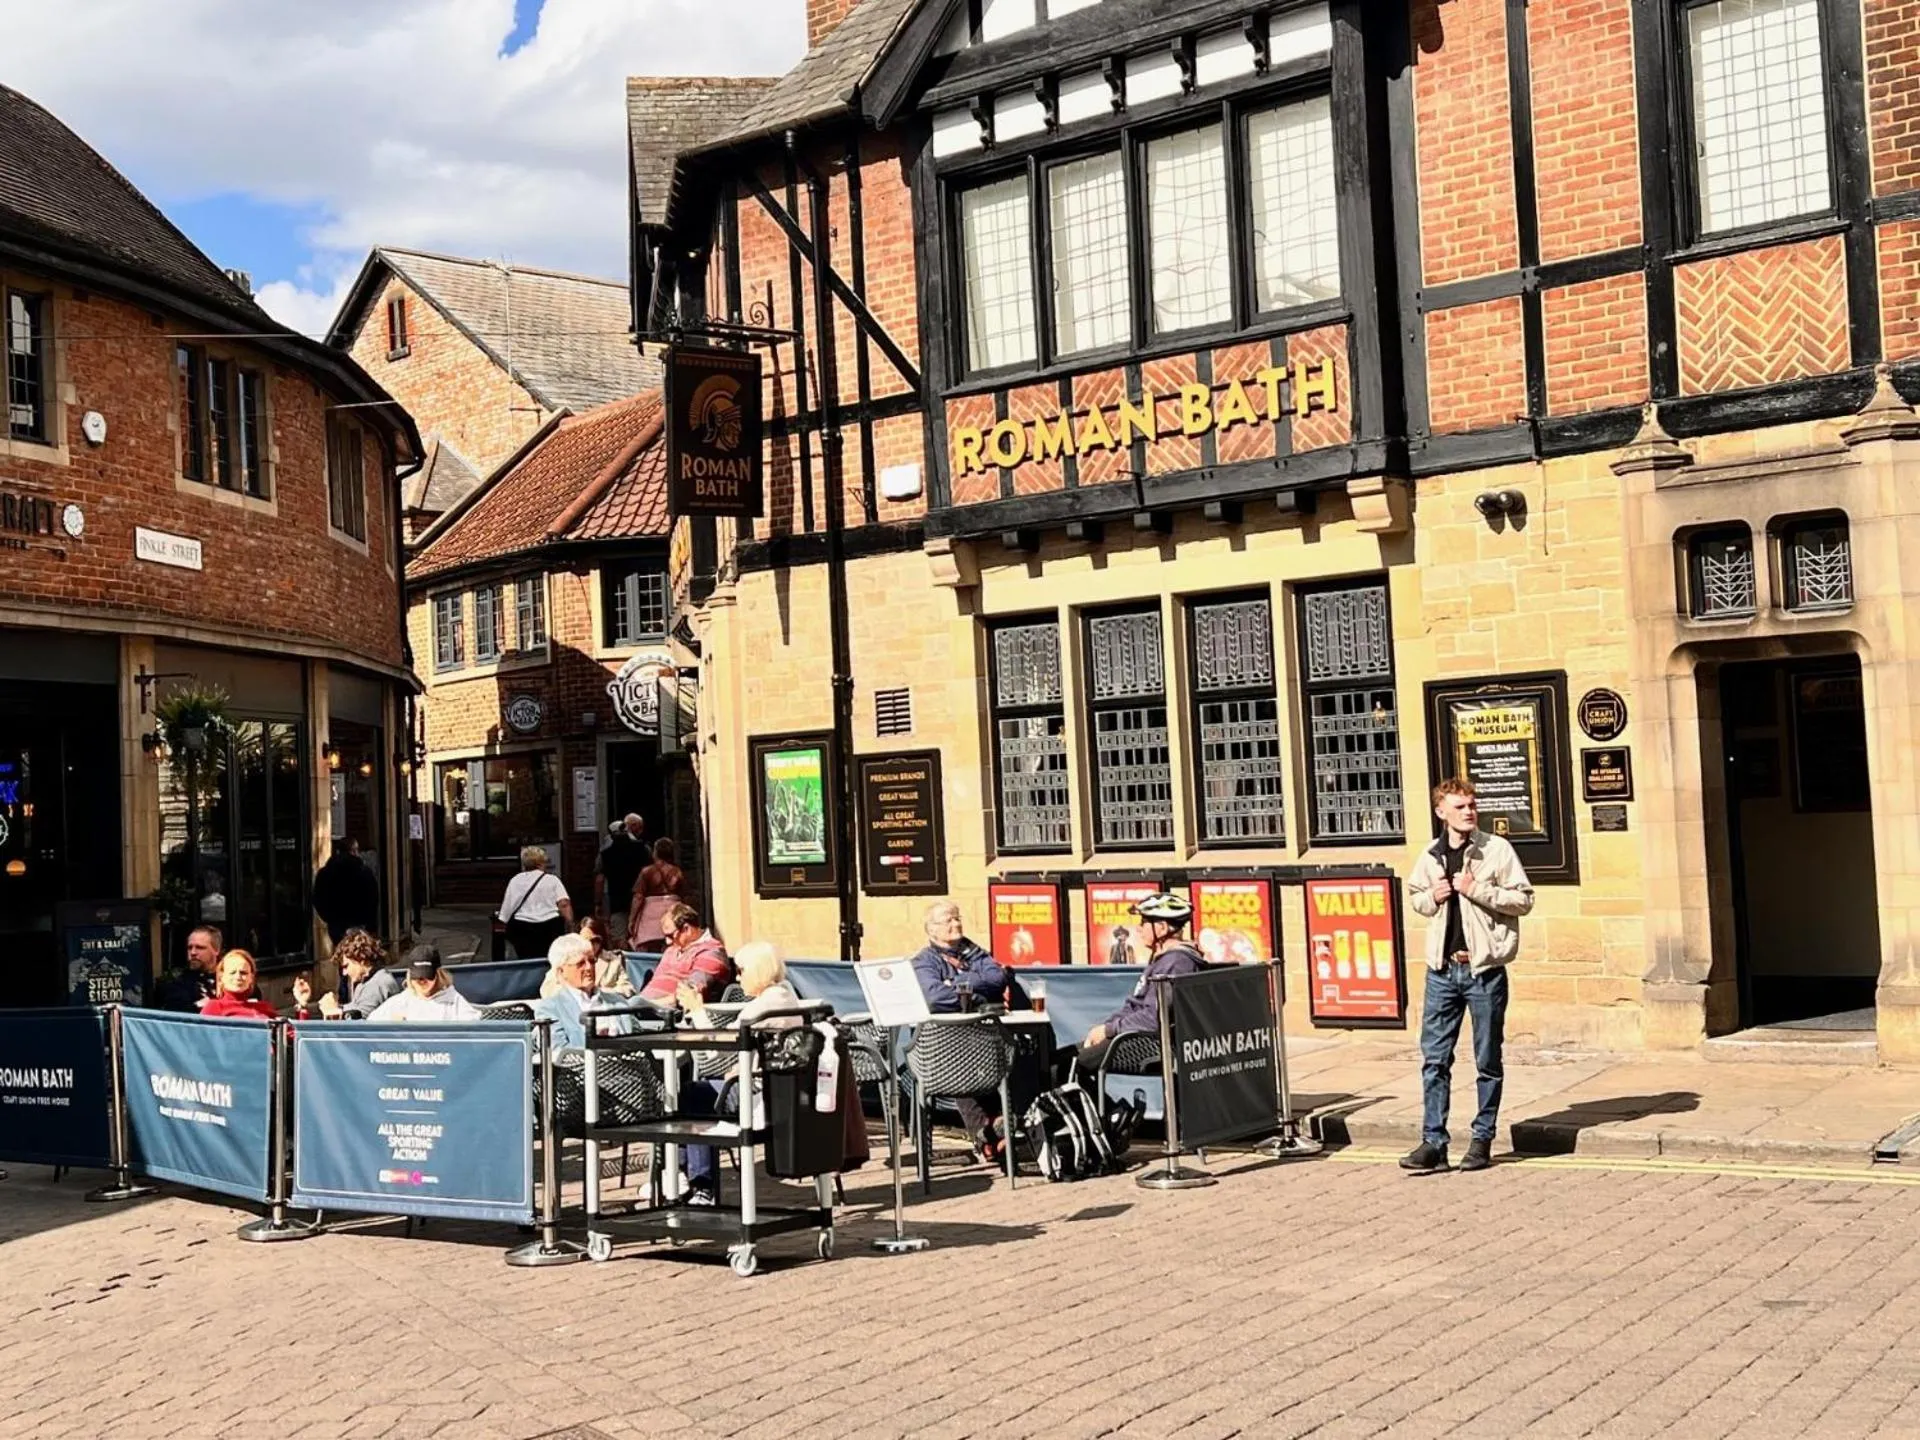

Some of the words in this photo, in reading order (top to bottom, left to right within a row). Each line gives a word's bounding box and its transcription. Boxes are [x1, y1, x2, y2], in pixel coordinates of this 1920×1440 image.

[955, 392, 1158, 476] ROMAN
[1180, 357, 1339, 436] BATH
[681, 452, 752, 482] ROMAN
[695, 479, 739, 497] BATH
[641, 699, 659, 715] BA
[1589, 710, 1614, 718] CRAFT
[1460, 713, 1500, 726] ROMAN
[1503, 712, 1530, 723] BATH
[1589, 717, 1615, 725] UNION
[1473, 725, 1519, 736] MUSEUM
[869, 773, 899, 782] PREMIUM
[900, 771, 926, 780] BRANDS
[878, 792, 899, 801] GREAT
[899, 791, 919, 800] VALUE
[883, 812, 895, 821] ALL
[895, 810, 915, 820] GREAT
[872, 821, 903, 830] SPORTING
[903, 818, 928, 828] ACTION
[1200, 892, 1262, 914] DISCO
[1312, 891, 1386, 917] VALUE
[88, 977, 121, 989] STEAK
[88, 989, 123, 1002] £16.00
[1183, 1033, 1232, 1064] ROMAN
[1235, 1026, 1271, 1053] BATH
[369, 1051, 411, 1064] PREMIUM
[412, 1052, 451, 1065] BRANDS
[1189, 1067, 1207, 1082] CRAFT
[1207, 1063, 1231, 1077] UNION
[1243, 1056, 1268, 1070] HOUSE
[0, 1067, 39, 1089] ROMAN
[41, 1067, 74, 1089] BATH
[150, 1073, 201, 1102] ROMAN
[198, 1081, 233, 1108] BATH
[378, 1087, 409, 1101] GREAT
[411, 1088, 444, 1102] VALUE
[377, 1123, 395, 1136] ALL
[395, 1123, 413, 1136] THE
[413, 1124, 443, 1137] GREAT
[387, 1136, 433, 1149] SPORTING
[392, 1149, 428, 1161] ACTION
